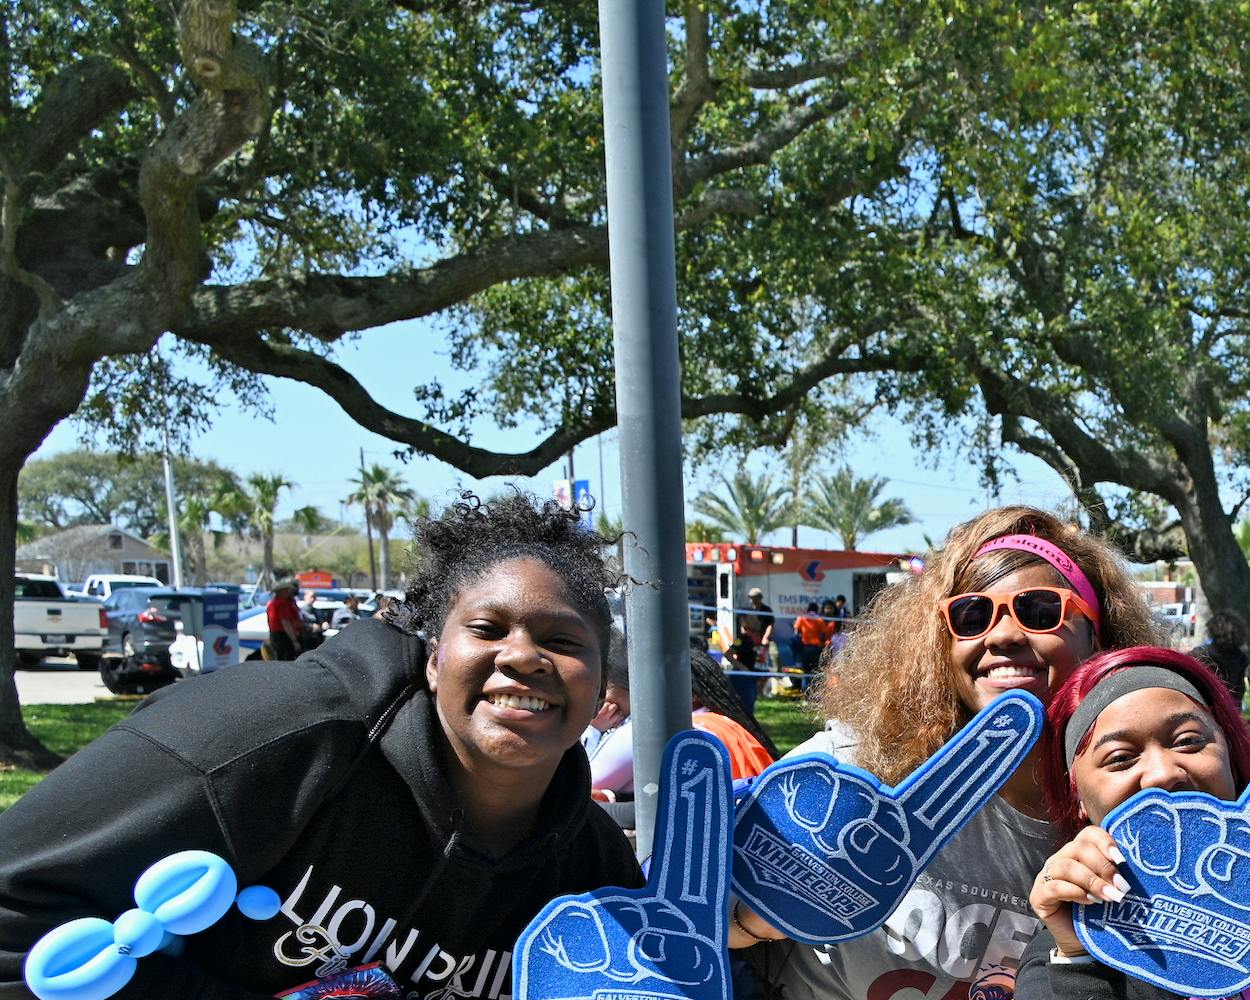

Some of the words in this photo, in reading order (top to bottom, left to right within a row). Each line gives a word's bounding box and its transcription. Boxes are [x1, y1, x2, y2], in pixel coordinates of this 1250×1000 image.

[913, 714, 1020, 831] #1
[679, 758, 715, 905] #1
[750, 832, 861, 915] WHITECAPS
[792, 847, 841, 886] GALVESTON
[840, 883, 874, 907] COLLEGE
[917, 873, 954, 890] EXAS
[960, 883, 1029, 909] SOUTHER
[1154, 899, 1212, 924] GALVESTON
[280, 864, 420, 974] LION
[883, 888, 1040, 979] OCE
[1111, 901, 1247, 955] WHITECAPS
